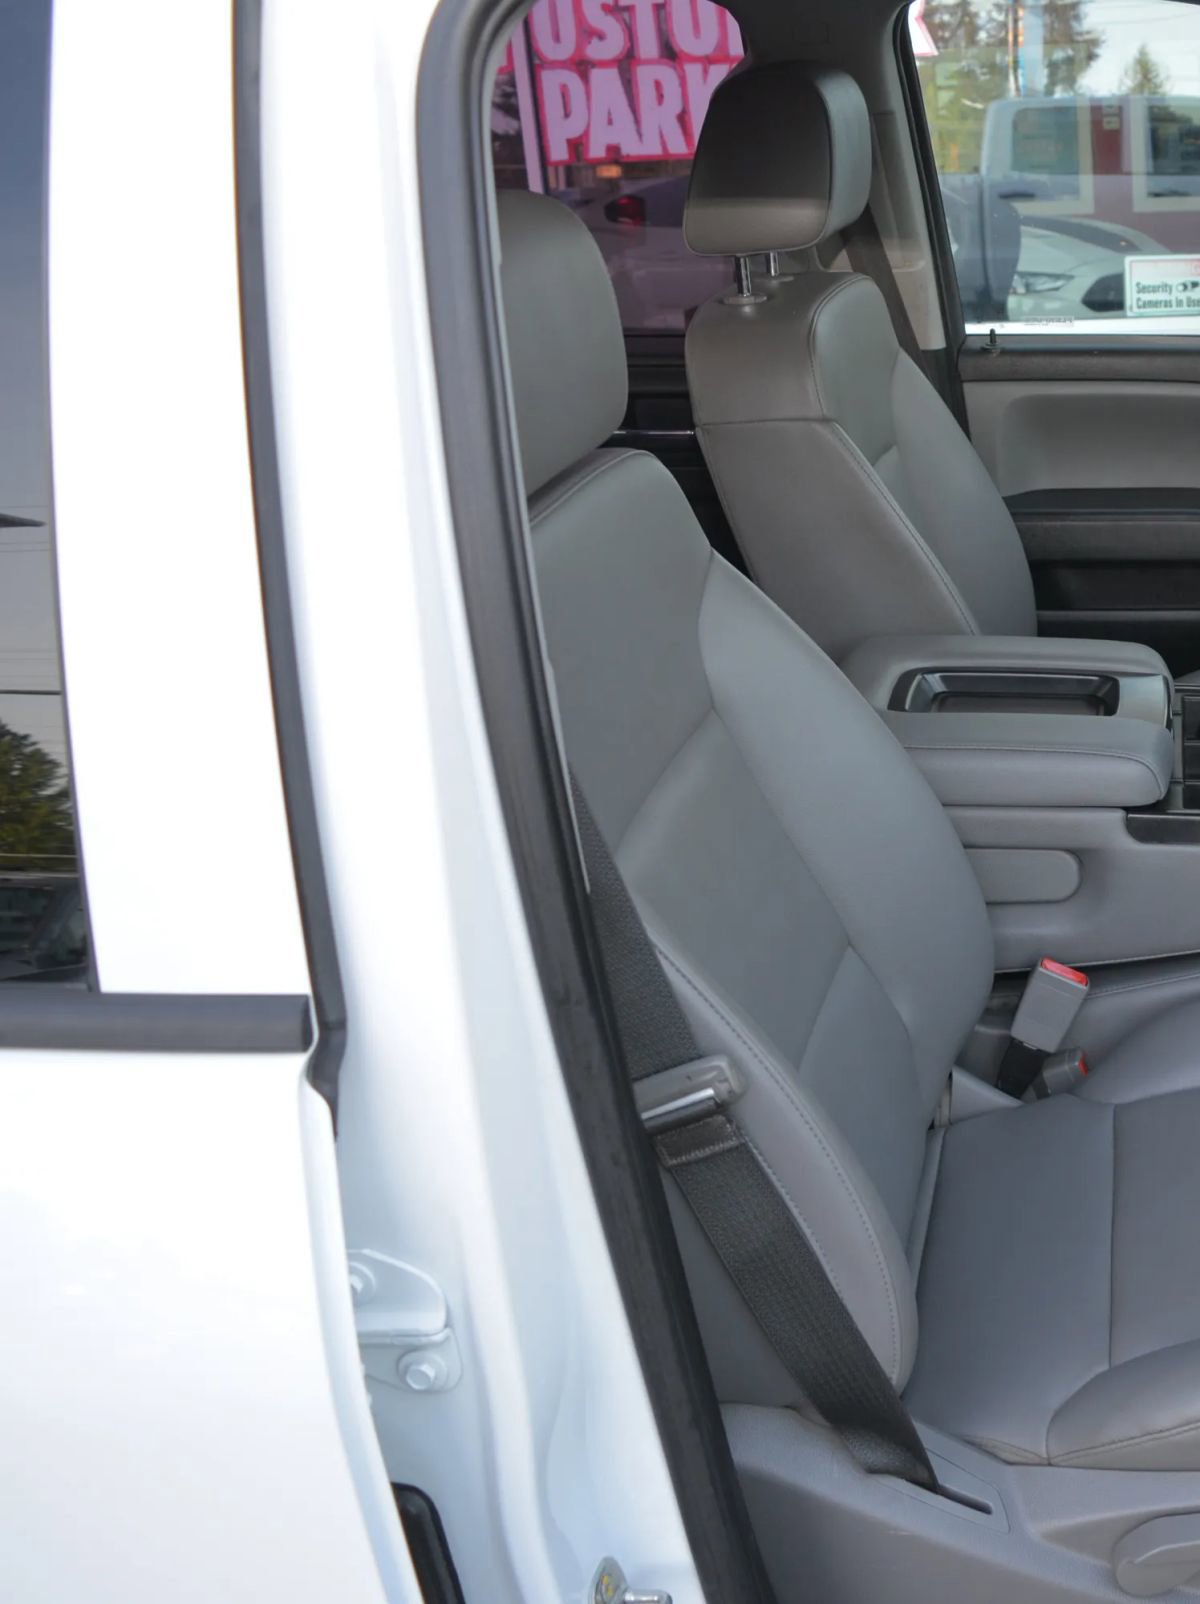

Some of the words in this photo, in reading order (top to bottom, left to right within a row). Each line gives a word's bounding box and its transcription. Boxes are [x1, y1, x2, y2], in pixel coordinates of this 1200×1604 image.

[532, 0, 744, 60] USTO
[1136, 281, 1173, 295] Security
[1136, 297, 1173, 309] Cameras
